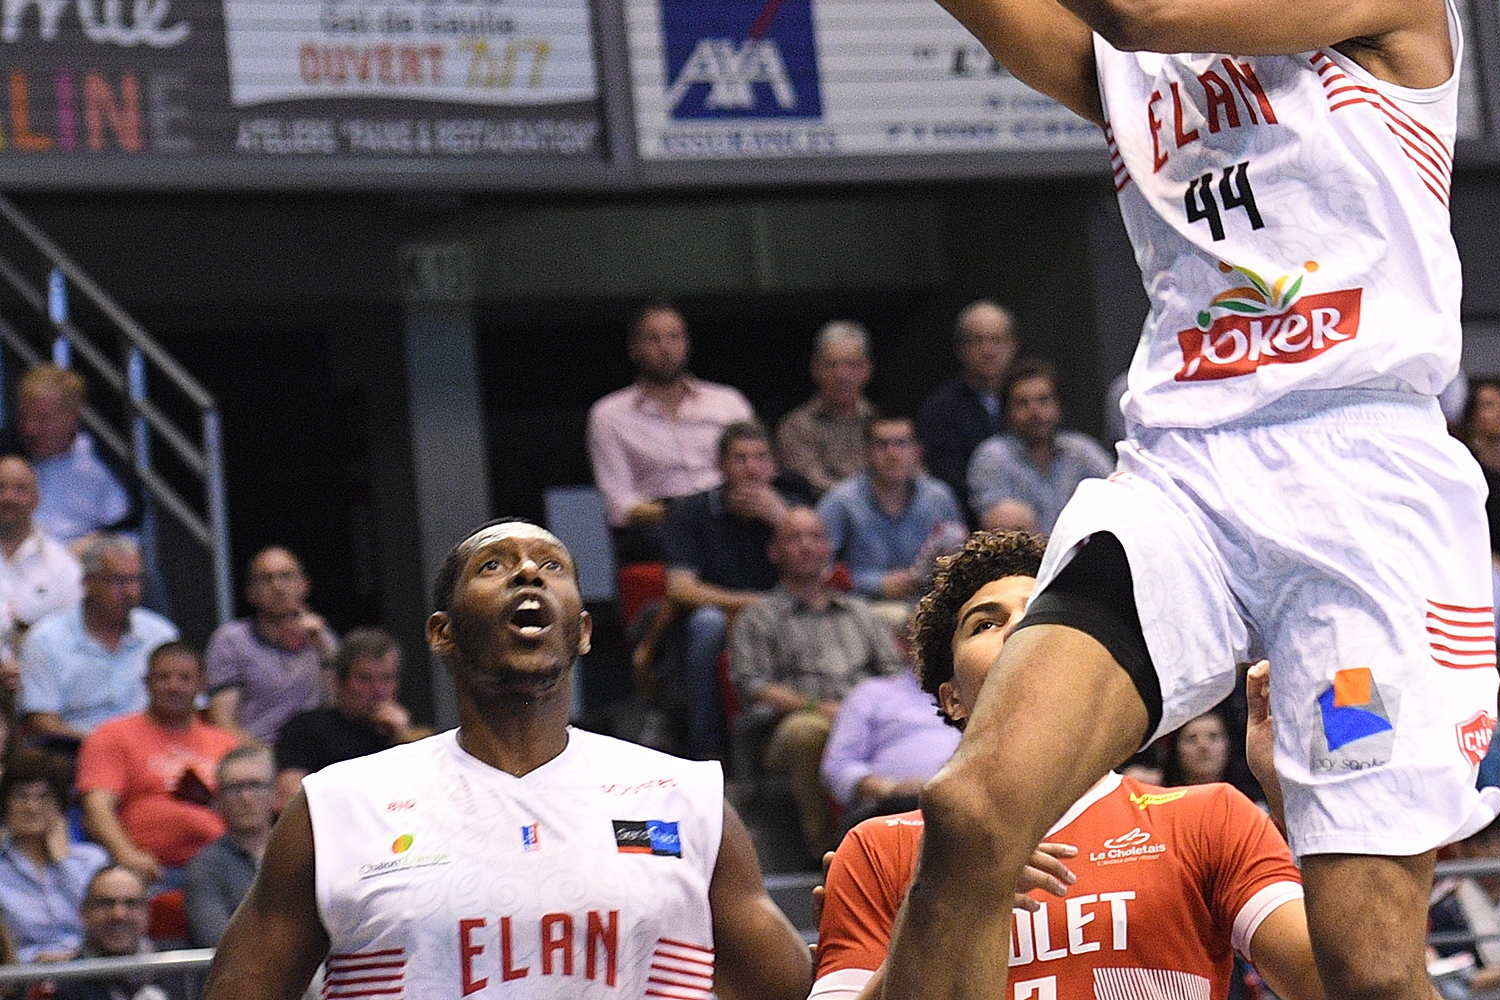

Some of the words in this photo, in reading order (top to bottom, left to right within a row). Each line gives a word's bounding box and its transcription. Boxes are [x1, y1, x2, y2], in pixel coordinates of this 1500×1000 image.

[299, 41, 444, 86] OUVERT
[667, 37, 798, 111] AXA
[0, 68, 196, 155] LINE
[1147, 58, 1279, 174] ELAN
[1183, 160, 1265, 243] 44
[1089, 851, 1106, 862] Le
[1107, 842, 1167, 859] Choletais
[459, 909, 620, 998] ELAN
